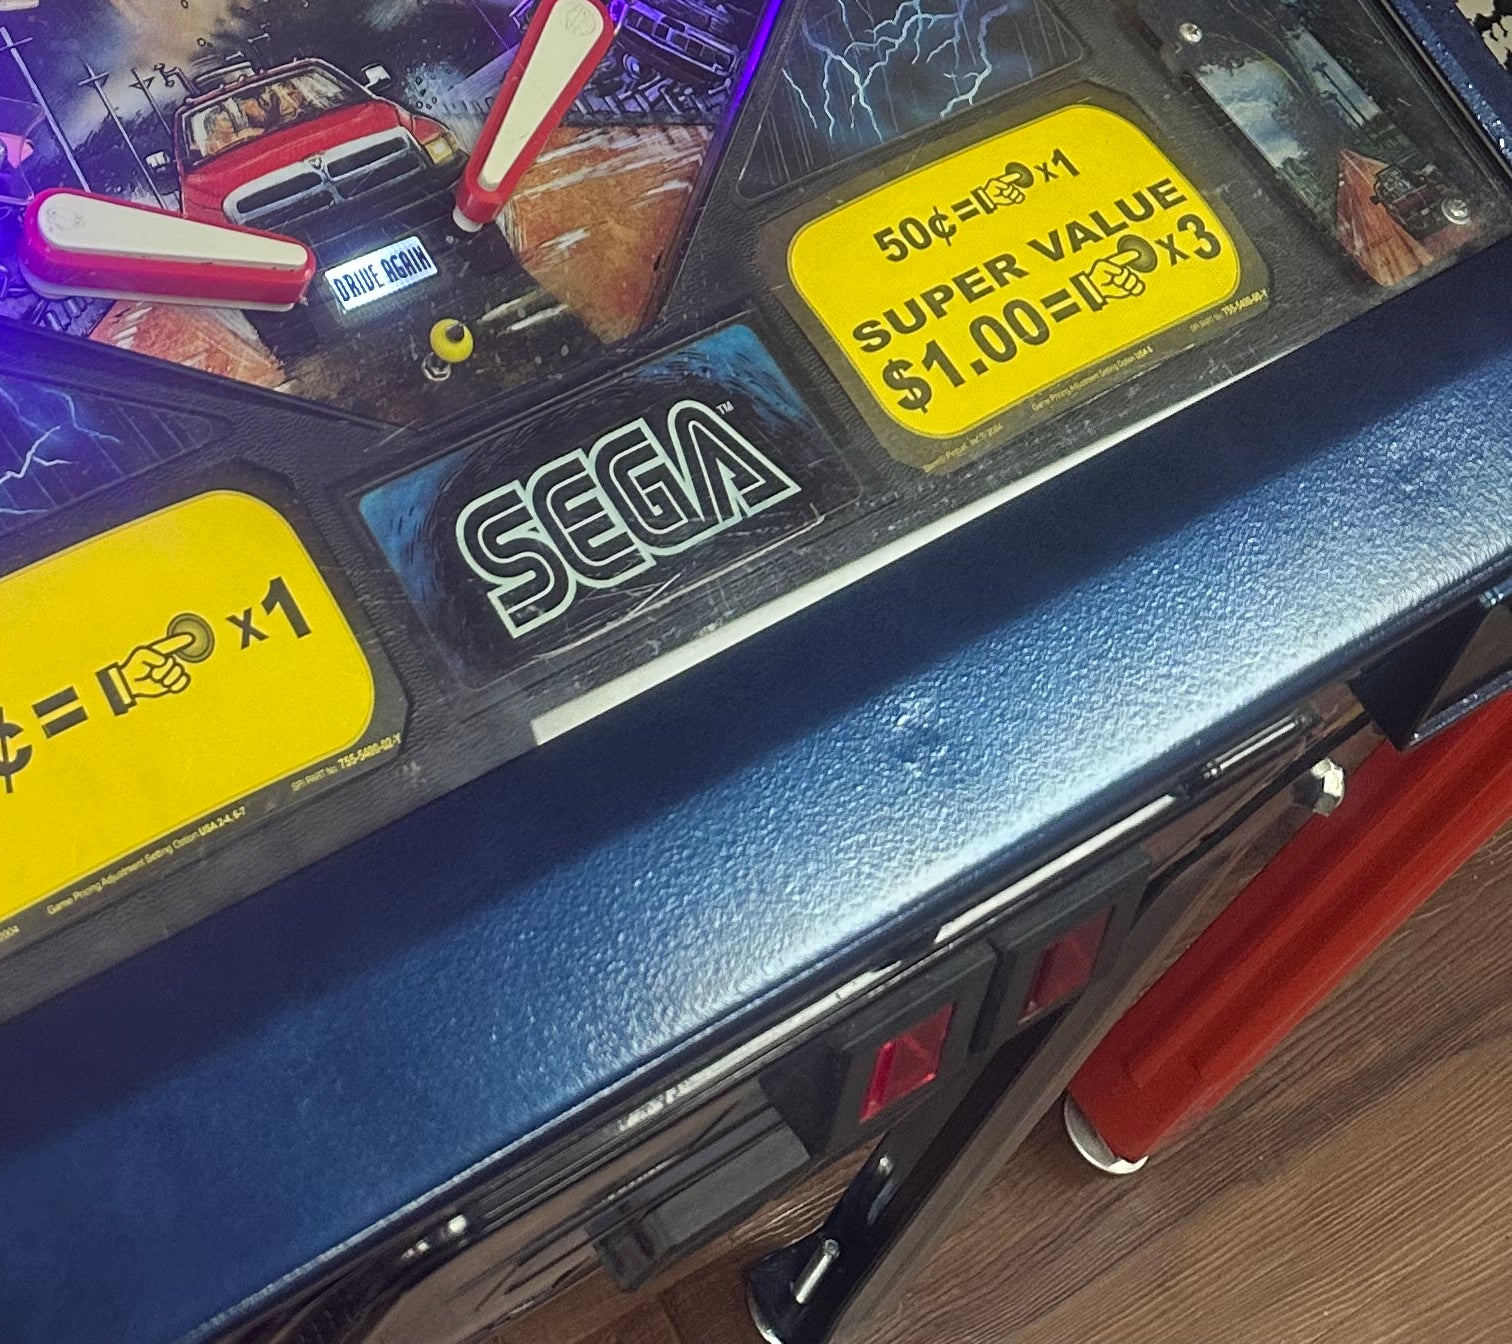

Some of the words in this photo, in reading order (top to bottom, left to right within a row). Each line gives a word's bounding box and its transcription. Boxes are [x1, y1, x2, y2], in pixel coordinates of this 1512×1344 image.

[333, 264, 386, 302] DRIVE
[381, 245, 432, 283] AGAIN
[851, 252, 1031, 354] SUPER
[1027, 177, 1189, 264] VALUE
[455, 399, 802, 639] SEGA
[46, 897, 74, 915] Game
[72, 882, 103, 902] Pricing
[101, 858, 146, 888] Adjustment
[144, 845, 174, 864] Setting
[172, 830, 199, 849] Option
[198, 822, 218, 837] USA
